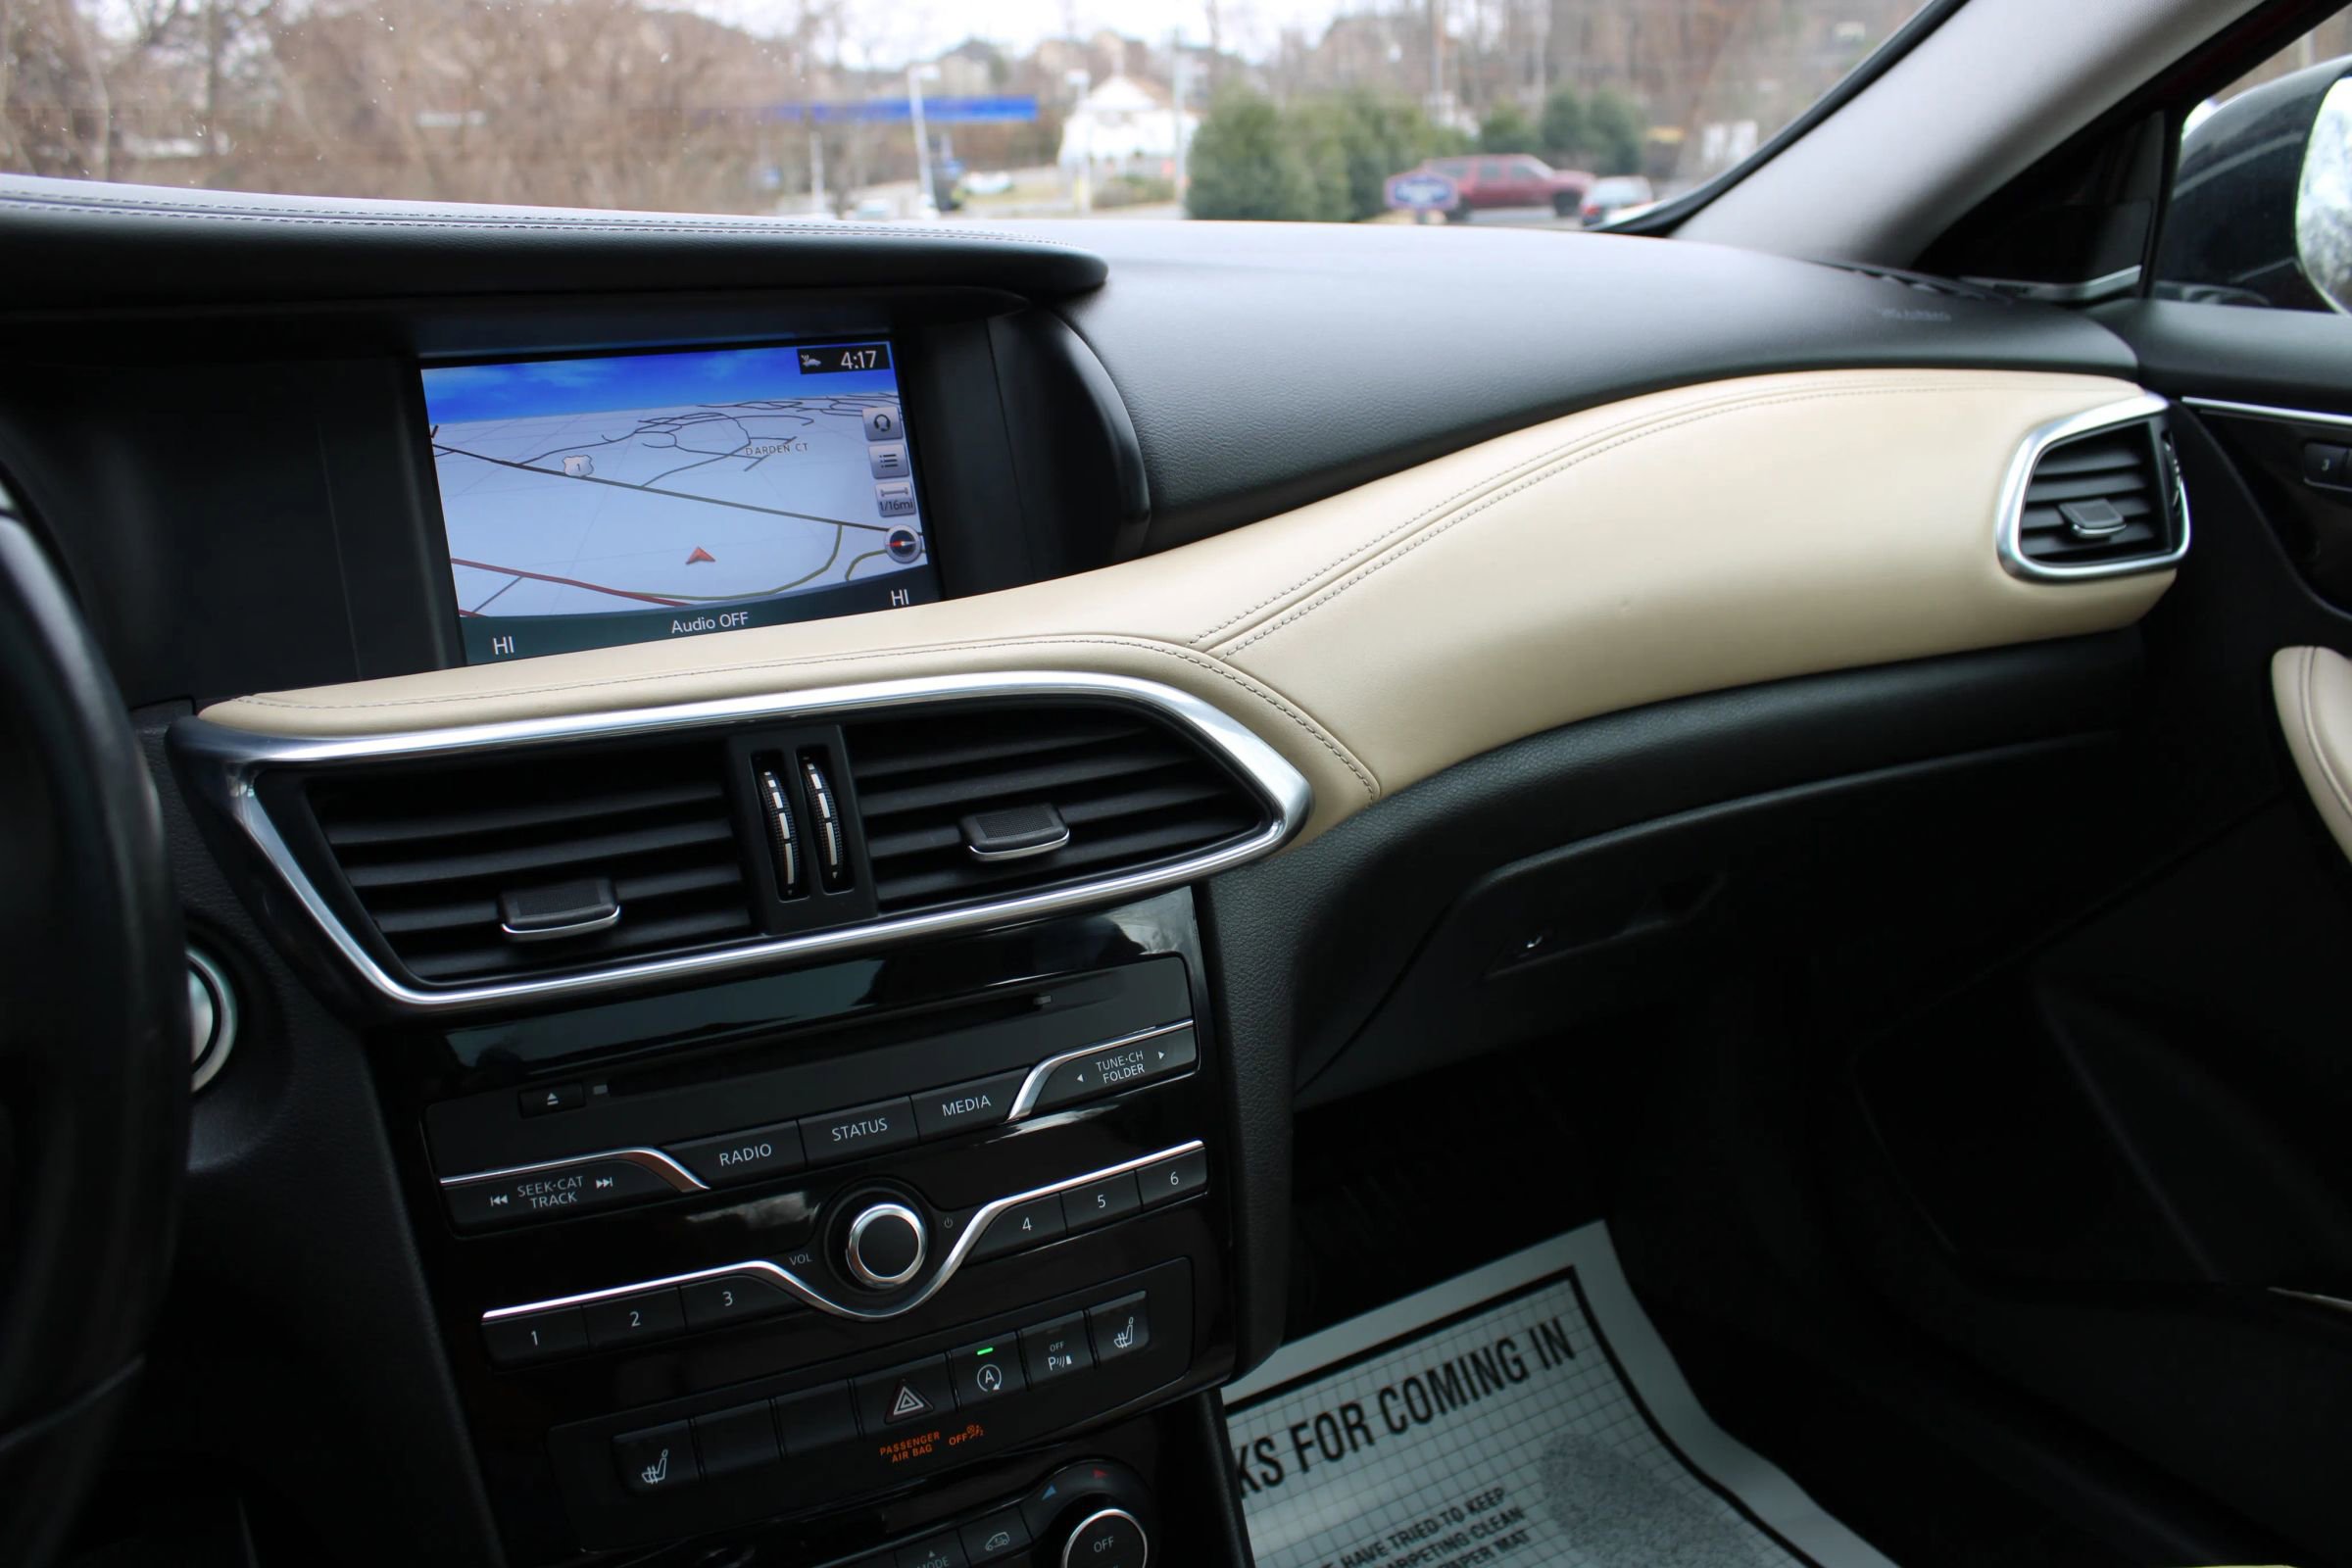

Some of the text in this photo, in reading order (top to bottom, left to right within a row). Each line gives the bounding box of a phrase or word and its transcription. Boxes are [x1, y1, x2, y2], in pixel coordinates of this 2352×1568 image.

[841, 351, 877, 369] 4:17
[745, 443, 808, 456] DARDEN CT
[879, 500, 913, 512] 1/16mi
[890, 589, 909, 607] HI
[671, 612, 749, 634] Audio OFF
[493, 637, 514, 655] HI
[1102, 1064, 1145, 1084] FOLDER
[942, 1095, 992, 1117] MEDIA
[831, 1118, 888, 1142] STATUS
[719, 1144, 772, 1166] RADIO
[1170, 1172, 1179, 1186] 6
[530, 1192, 577, 1210] TRACK
[1098, 1195, 1106, 1208] 5
[1022, 1217, 1032, 1232] 4
[789, 1253, 812, 1266] VOL
[723, 1292, 733, 1306] 3
[629, 1311, 641, 1327] 2
[531, 1331, 538, 1346] 1
[1050, 1341, 1065, 1352] OFF
[1290, 1400, 1375, 1474] FOR
[1378, 1337, 1531, 1436] COMING
[1528, 1316, 1577, 1370] IN
[880, 1431, 941, 1455] PASSENGER
[949, 1434, 967, 1446] OFF
[892, 1444, 933, 1462] AIR BAG
[1341, 1487, 1504, 1568] HAVE TRIED TO KEEP
[1470, 1506, 1526, 1540] CLEAN
[1094, 1536, 1114, 1553] OFF
[1494, 1530, 1531, 1553] MAT
[916, 1555, 950, 1568] ODE
